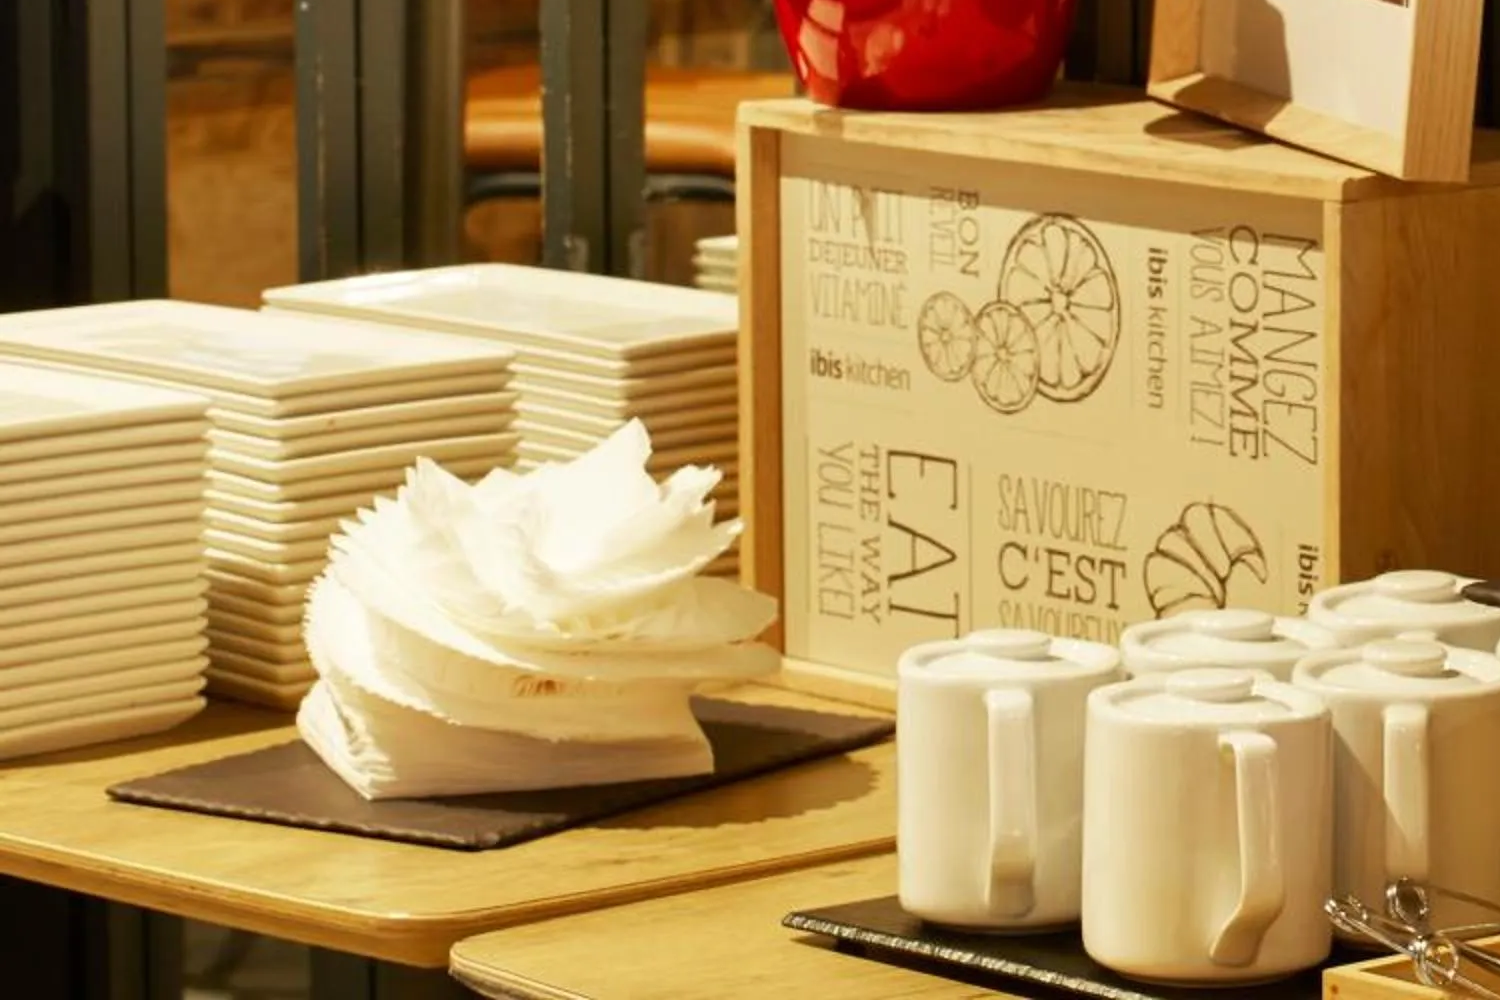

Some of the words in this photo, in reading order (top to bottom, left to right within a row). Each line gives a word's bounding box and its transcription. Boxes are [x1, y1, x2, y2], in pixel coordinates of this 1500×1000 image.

[957, 189, 980, 278] BON
[1147, 247, 1168, 299] ibis
[810, 348, 843, 379] ibis
[846, 357, 911, 391] kitchen
[1147, 305, 1168, 410] kitchen
[1228, 224, 1260, 460] COMME
[1262, 232, 1319, 466] MANGEZ
[817, 440, 855, 510] YOU
[859, 443, 881, 523] THE
[998, 473, 1129, 551] SAVOUREZ
[860, 535, 882, 627] WAY
[887, 448, 960, 640] EAT
[998, 540, 1127, 611] C'EST
[1297, 543, 1320, 597] ibis
